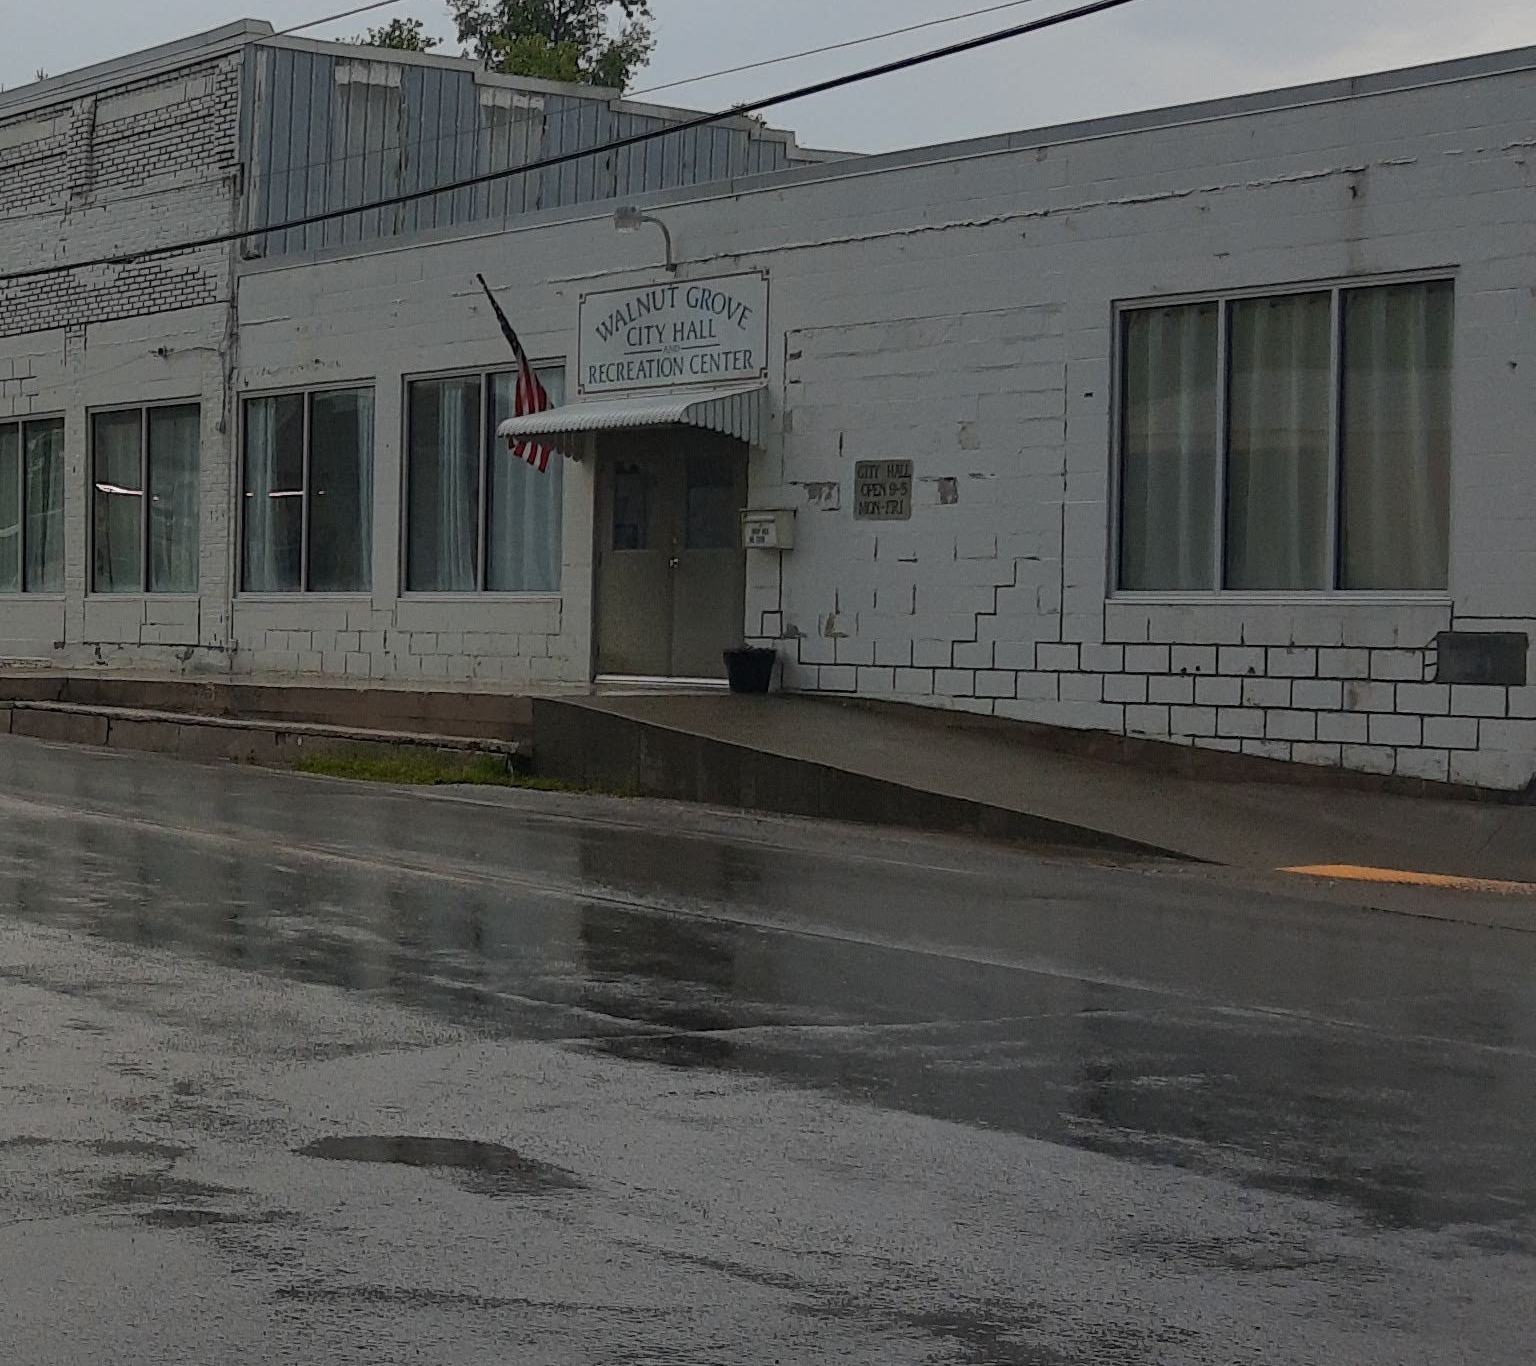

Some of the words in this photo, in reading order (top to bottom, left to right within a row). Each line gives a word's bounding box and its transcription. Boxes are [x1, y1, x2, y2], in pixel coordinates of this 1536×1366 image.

[595, 286, 679, 342] WALNUT
[686, 286, 753, 331] GROVE
[627, 323, 665, 347] CITY
[673, 319, 716, 342] HALL
[588, 357, 684, 384] RECREATION
[690, 350, 754, 375] CENTER
[857, 464, 880, 479] CITY
[887, 464, 911, 479] HALL
[861, 483, 886, 497] OPEN
